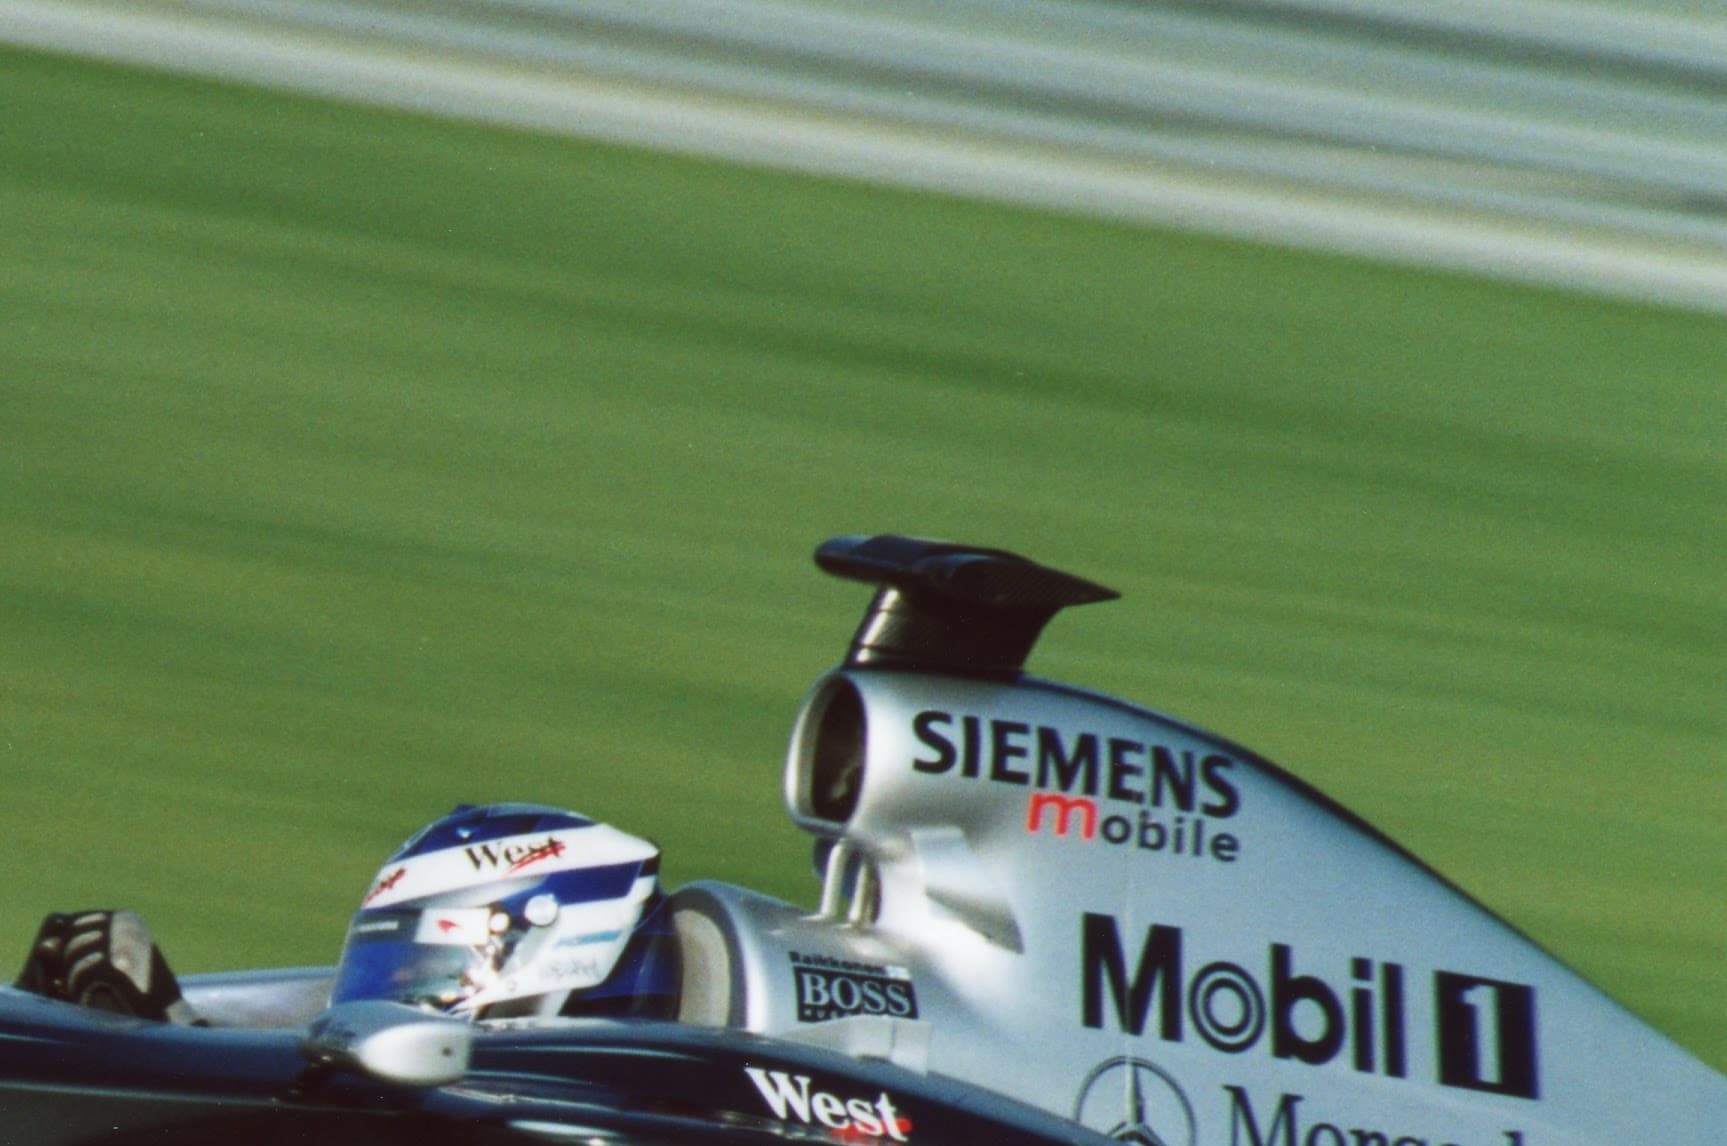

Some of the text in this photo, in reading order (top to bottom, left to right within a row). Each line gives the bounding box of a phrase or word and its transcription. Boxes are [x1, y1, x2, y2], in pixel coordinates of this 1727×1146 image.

[911, 709, 1242, 820] SIEMENS
[464, 836, 566, 872] West
[1027, 792, 1240, 863] mobile
[800, 972, 911, 1016] BOSS
[1081, 911, 1406, 1079] Mobil
[744, 1066, 909, 1142] West
